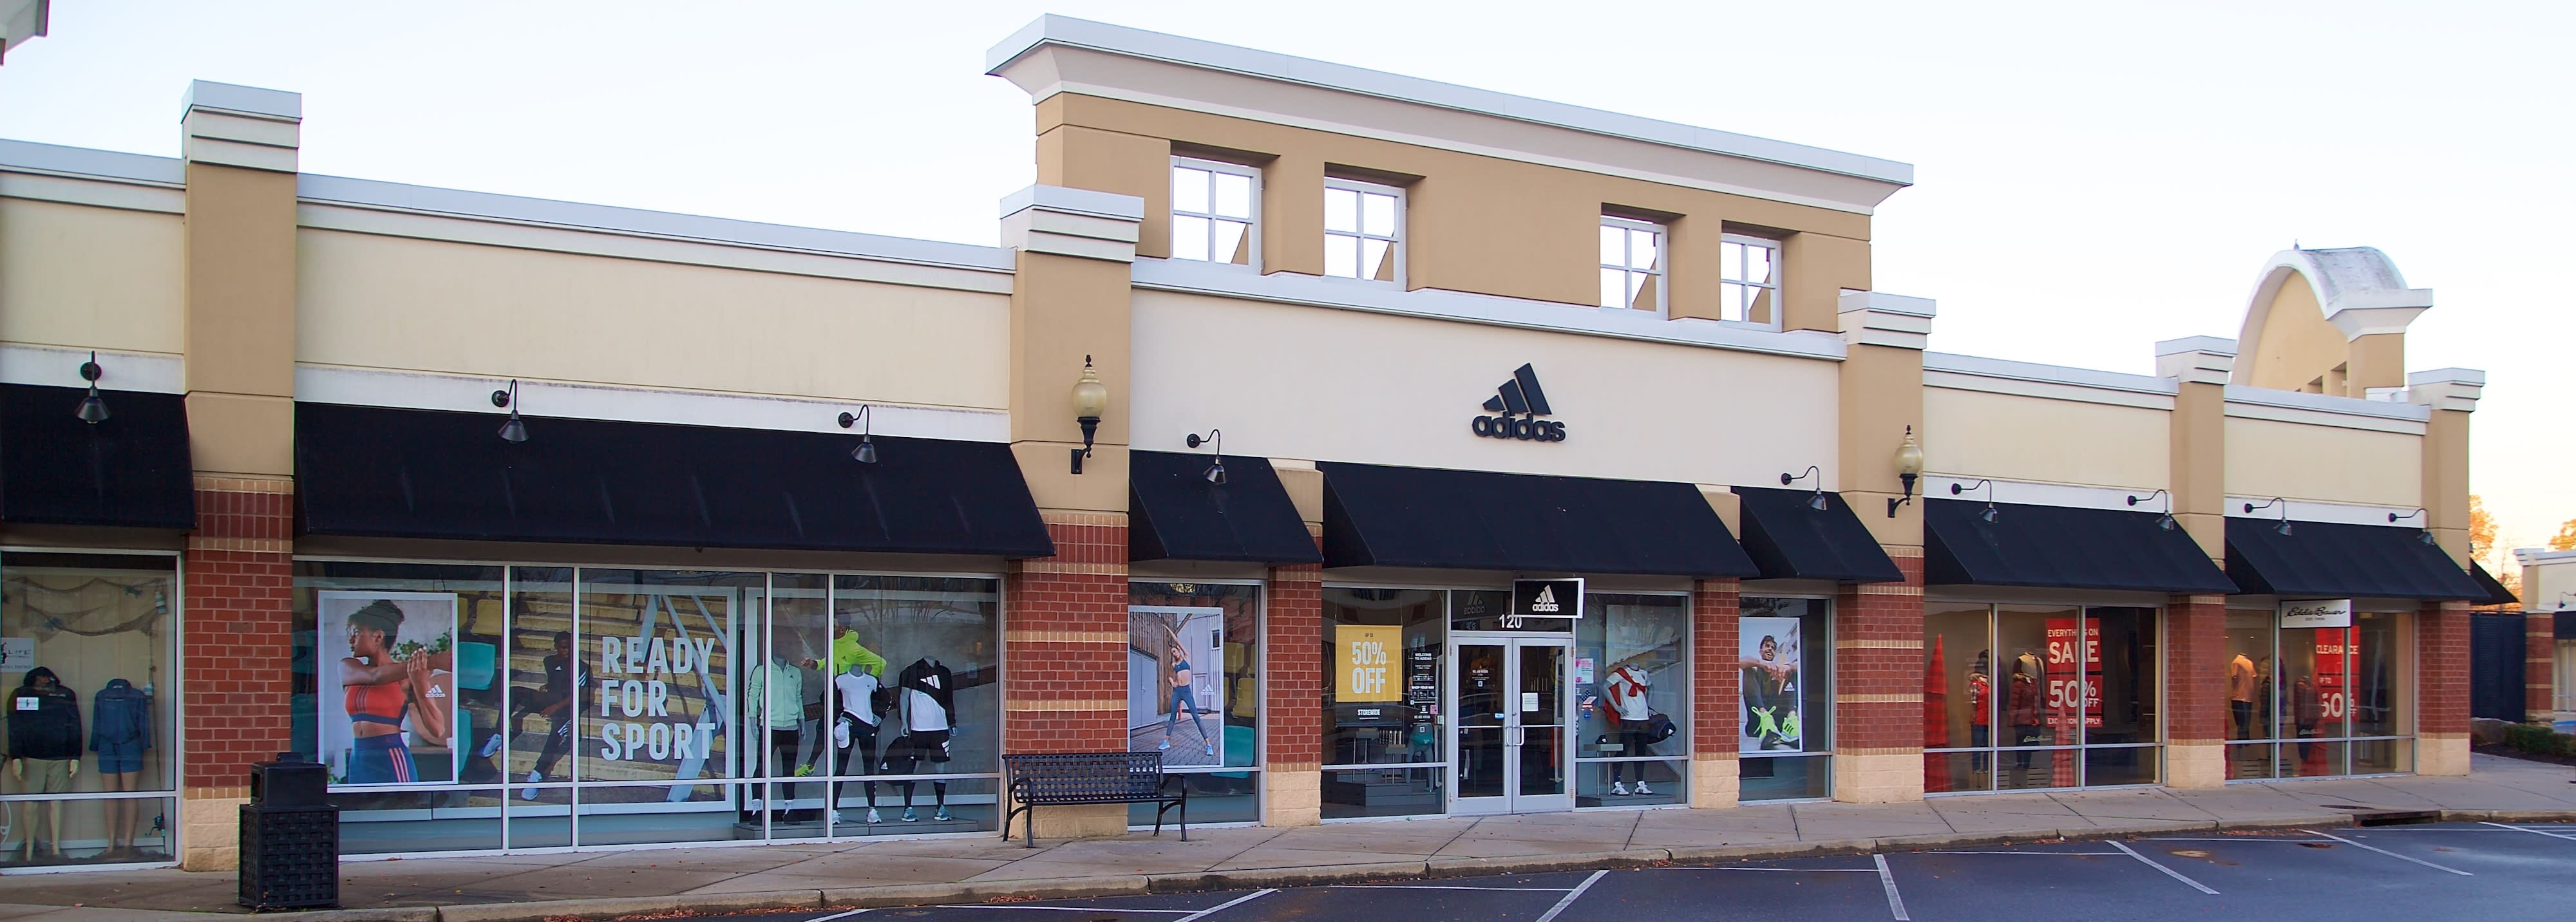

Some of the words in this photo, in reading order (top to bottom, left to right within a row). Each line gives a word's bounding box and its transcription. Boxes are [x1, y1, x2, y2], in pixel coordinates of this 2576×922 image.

[1472, 411, 1566, 442] adidas
[1532, 602, 1558, 612] adidas
[2284, 607, 2313, 617] Eddie
[2314, 607, 2346, 616] Bauer
[1499, 614, 1522, 628] 120
[2048, 628, 2087, 637] EVERYTH
[602, 636, 715, 673] READY
[1352, 641, 1387, 665] 50%
[2316, 644, 2358, 654] CLEARACE
[1352, 667, 1386, 693] OFF
[601, 679, 668, 717] FOR
[601, 722, 715, 761] SPORT
